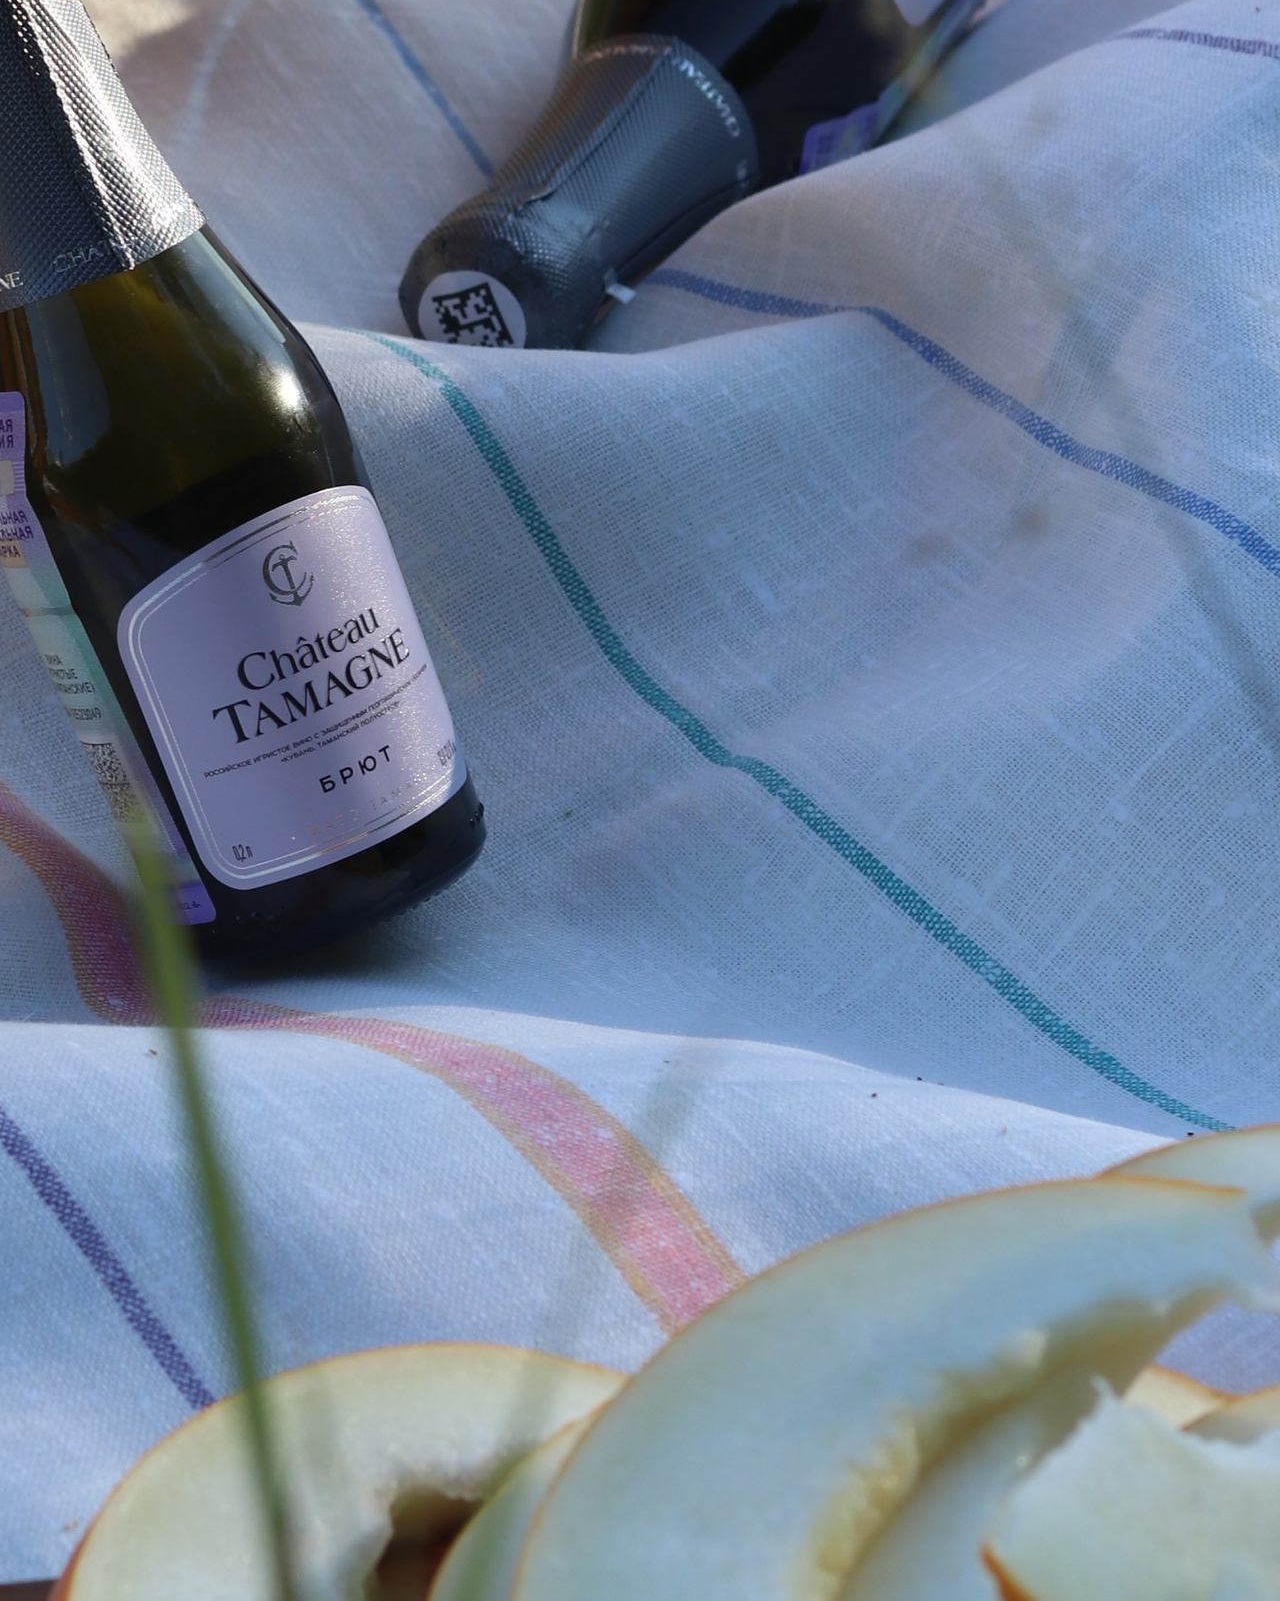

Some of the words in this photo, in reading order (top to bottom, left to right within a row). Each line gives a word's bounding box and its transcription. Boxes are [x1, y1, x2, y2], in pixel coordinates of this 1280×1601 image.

[237, 607, 380, 692] Château
[212, 628, 410, 745] TAMAGNE
[204, 759, 252, 778] РОССИЙСКОЕ
[253, 745, 291, 764] ИГРИСТОЕ
[292, 736, 313, 749] ВИНО
[317, 722, 360, 748] ТАМАНСКИЙ
[319, 745, 392, 794] БРЮТ
